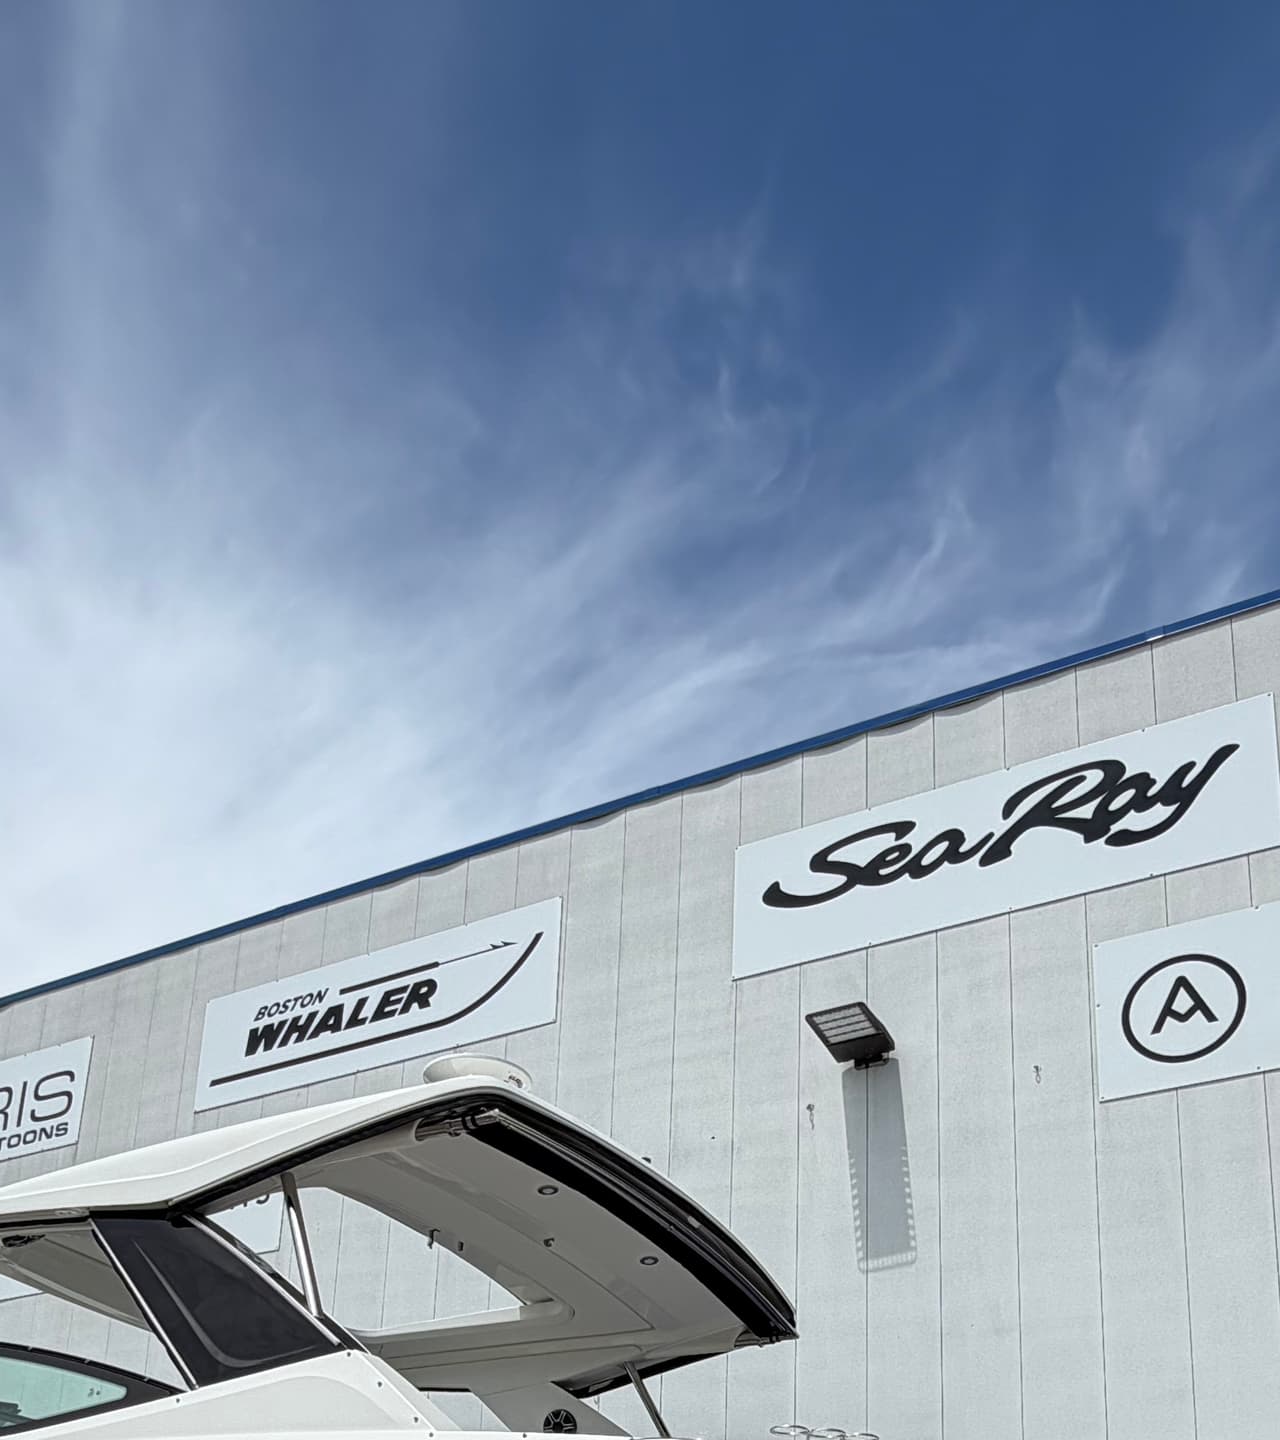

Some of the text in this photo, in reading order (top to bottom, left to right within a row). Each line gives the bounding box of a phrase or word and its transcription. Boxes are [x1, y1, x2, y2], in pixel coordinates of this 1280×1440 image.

[762, 743, 1241, 908] Sea Ray
[244, 978, 438, 1058] WHALER
[253, 987, 330, 1022] BOSTON
